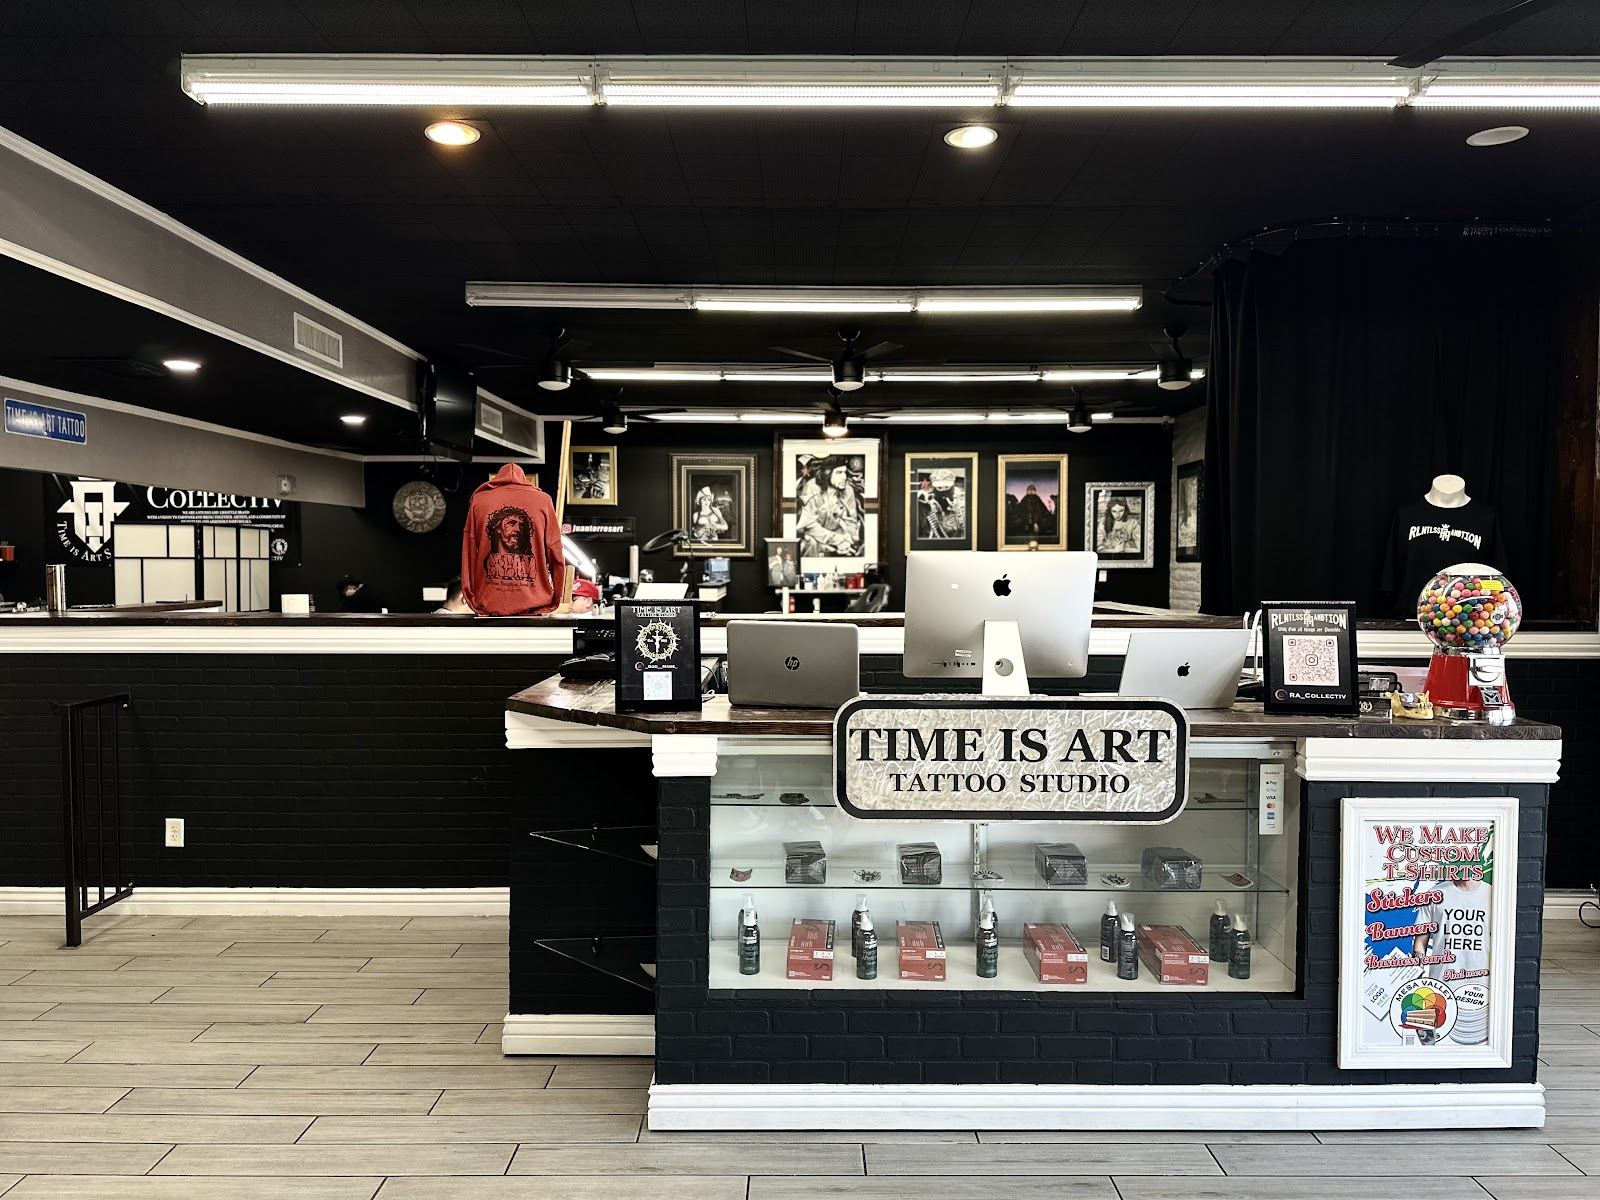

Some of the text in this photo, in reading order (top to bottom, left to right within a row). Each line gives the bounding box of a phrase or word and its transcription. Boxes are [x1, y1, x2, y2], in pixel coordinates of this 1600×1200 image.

[41, 412, 56, 433] ART
[57, 416, 85, 438] TATTOO
[57, 521, 71, 548] TIME
[70, 546, 80, 556] IS
[81, 550, 102, 562] ART
[785, 656, 800, 670] hp
[849, 728, 1171, 764] TIME IS ART
[890, 773, 1130, 794] TATTOO STUDIO
[1373, 824, 1488, 844] WE MAKE
[1386, 844, 1480, 863] CUSTOM
[1382, 862, 1484, 882] T-SHIRTS
[1366, 887, 1443, 912] Stickers
[1444, 909, 1486, 922] YOUR
[1366, 922, 1439, 942] Banners
[1444, 924, 1483, 936] LOGO
[1444, 938, 1482, 950] HERE
[1364, 950, 1456, 968] Business cards
[1443, 969, 1489, 981] And more
[1370, 988, 1384, 1004] LOGO
[1396, 980, 1454, 1002] MESA VALLEY
[1464, 990, 1484, 998] YOUR
[1456, 996, 1484, 1006] DESIGN
